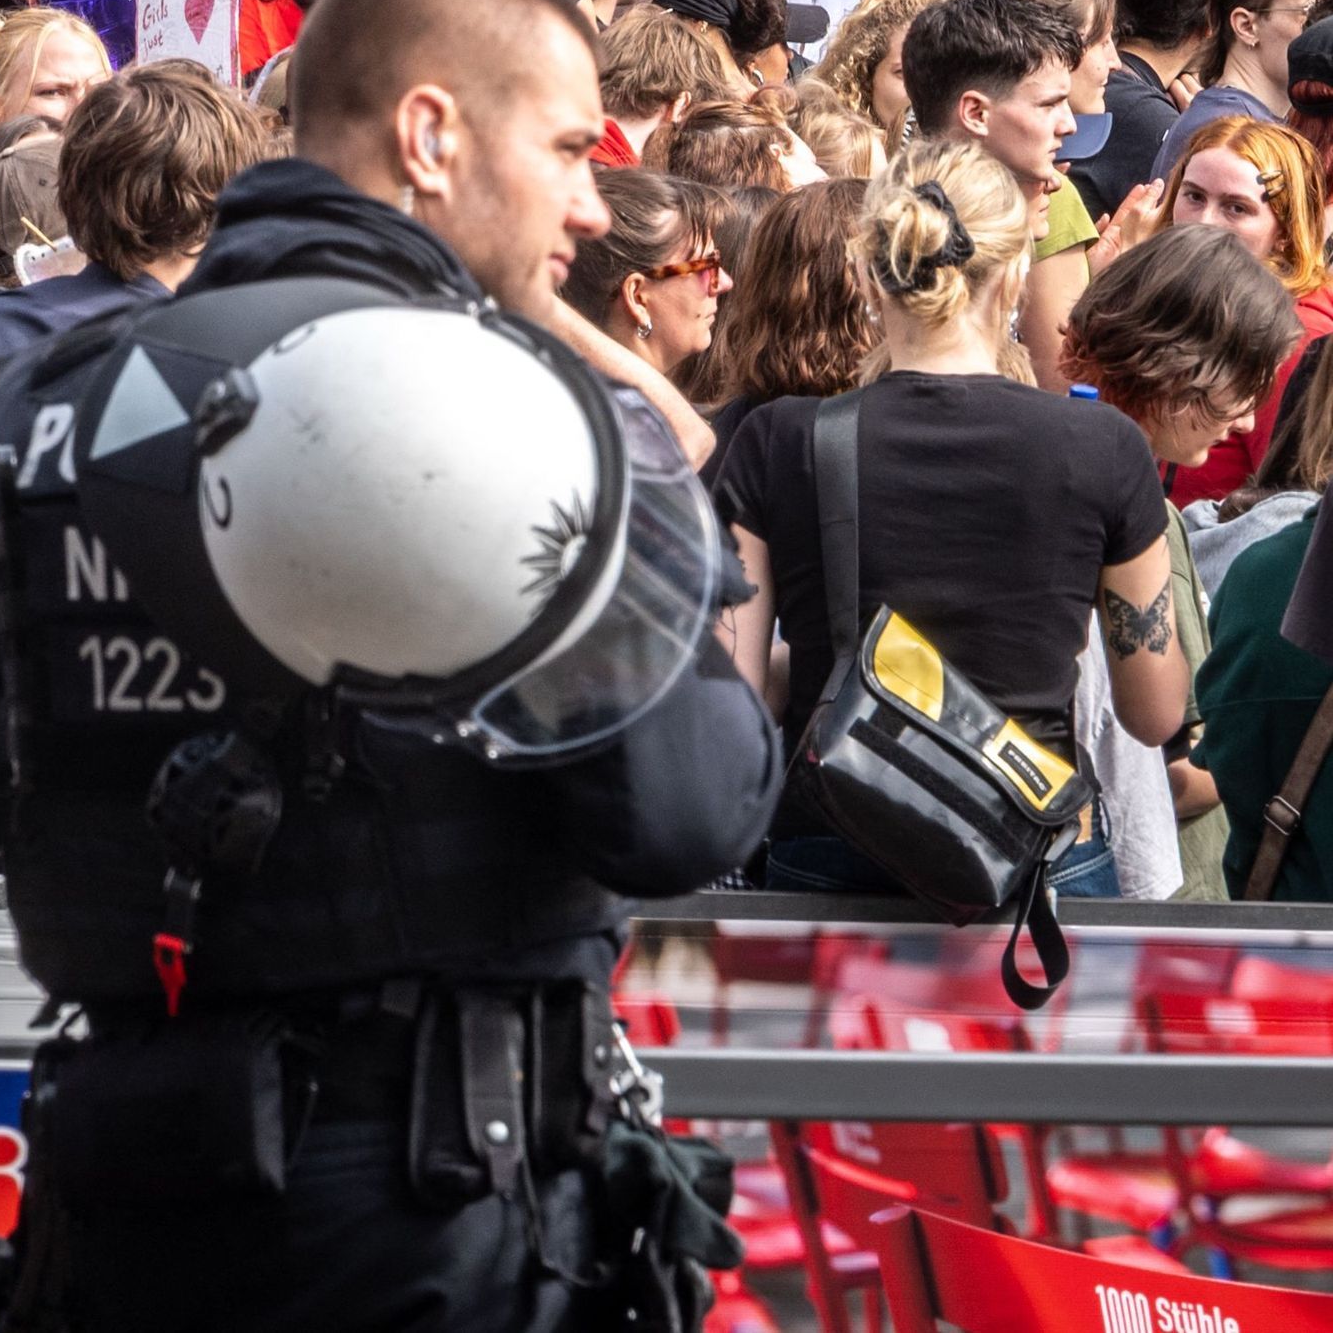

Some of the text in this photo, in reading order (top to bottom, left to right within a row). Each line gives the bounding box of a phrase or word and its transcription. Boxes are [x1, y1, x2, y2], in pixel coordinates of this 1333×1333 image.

[143, 33, 164, 57] just
[1094, 1284, 1241, 1333] 1000 Stühle
